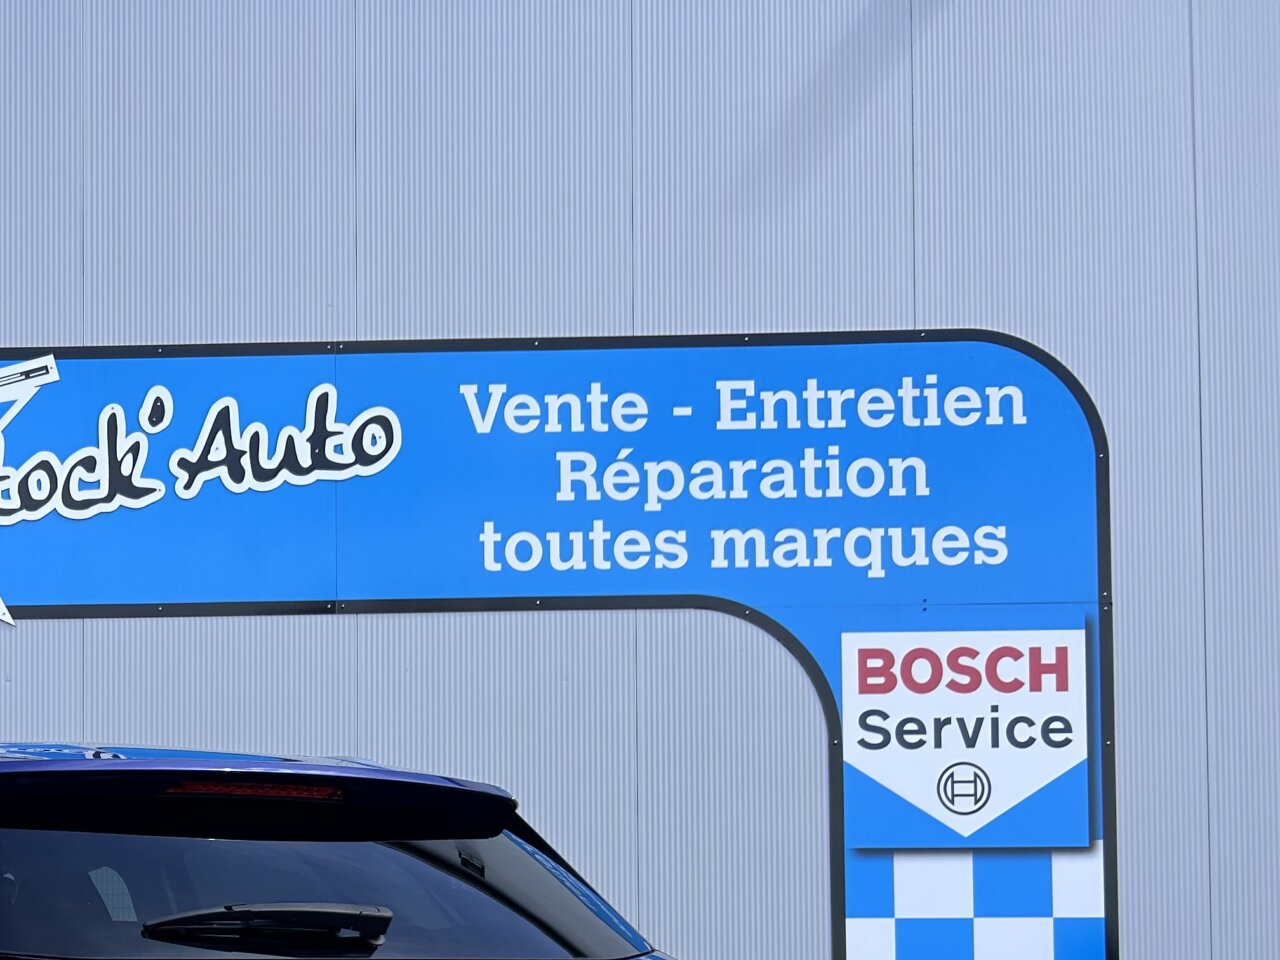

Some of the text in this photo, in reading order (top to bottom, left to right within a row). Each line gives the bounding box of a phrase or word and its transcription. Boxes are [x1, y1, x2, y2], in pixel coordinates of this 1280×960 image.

[460, 374, 1027, 434] Vente - Entretien
[555, 445, 930, 512] Réparation
[479, 519, 1009, 578] toutes marques
[857, 646, 1069, 695] BOSCH
[857, 704, 1074, 750] Service
